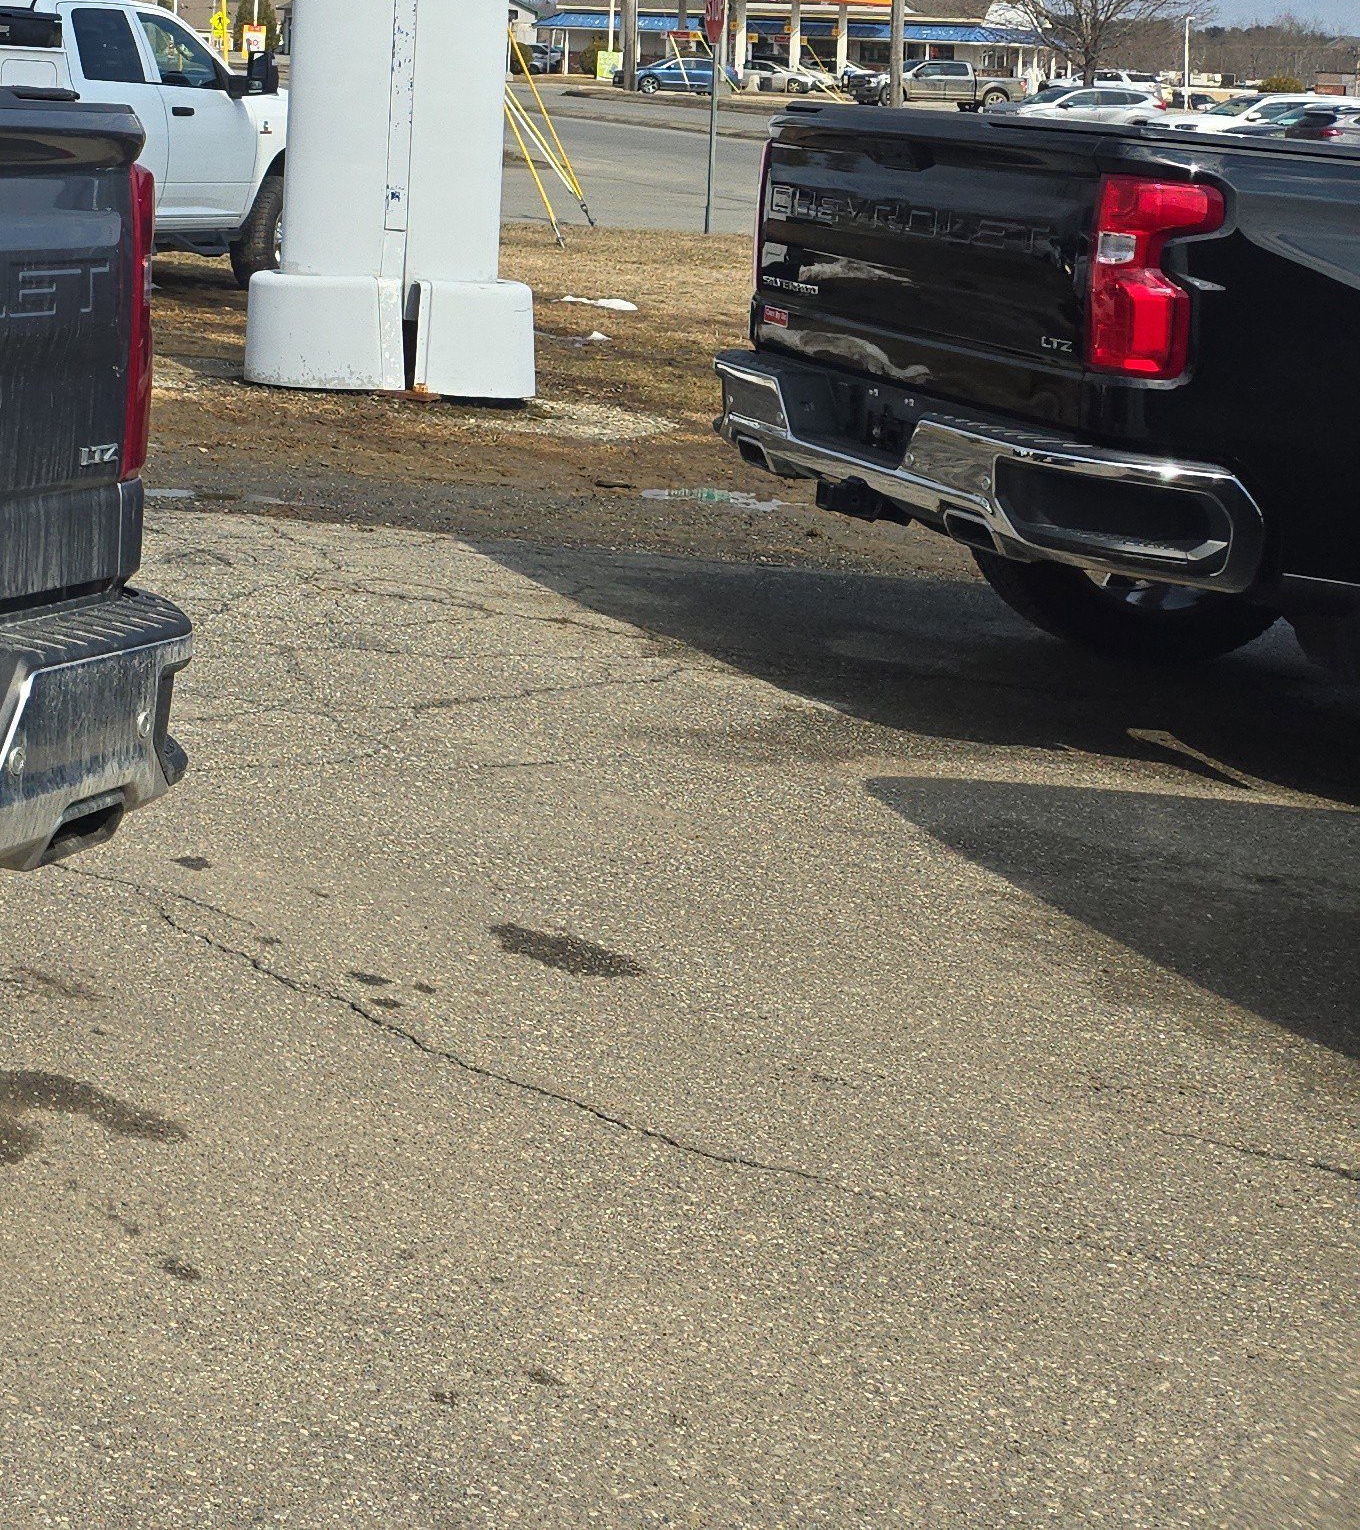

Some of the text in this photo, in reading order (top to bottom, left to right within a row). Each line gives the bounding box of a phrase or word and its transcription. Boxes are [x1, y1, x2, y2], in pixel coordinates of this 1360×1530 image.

[771, 183, 1051, 254] CHEVROLET
[1041, 335, 1073, 353] LTZ
[80, 443, 119, 466] LTZ
